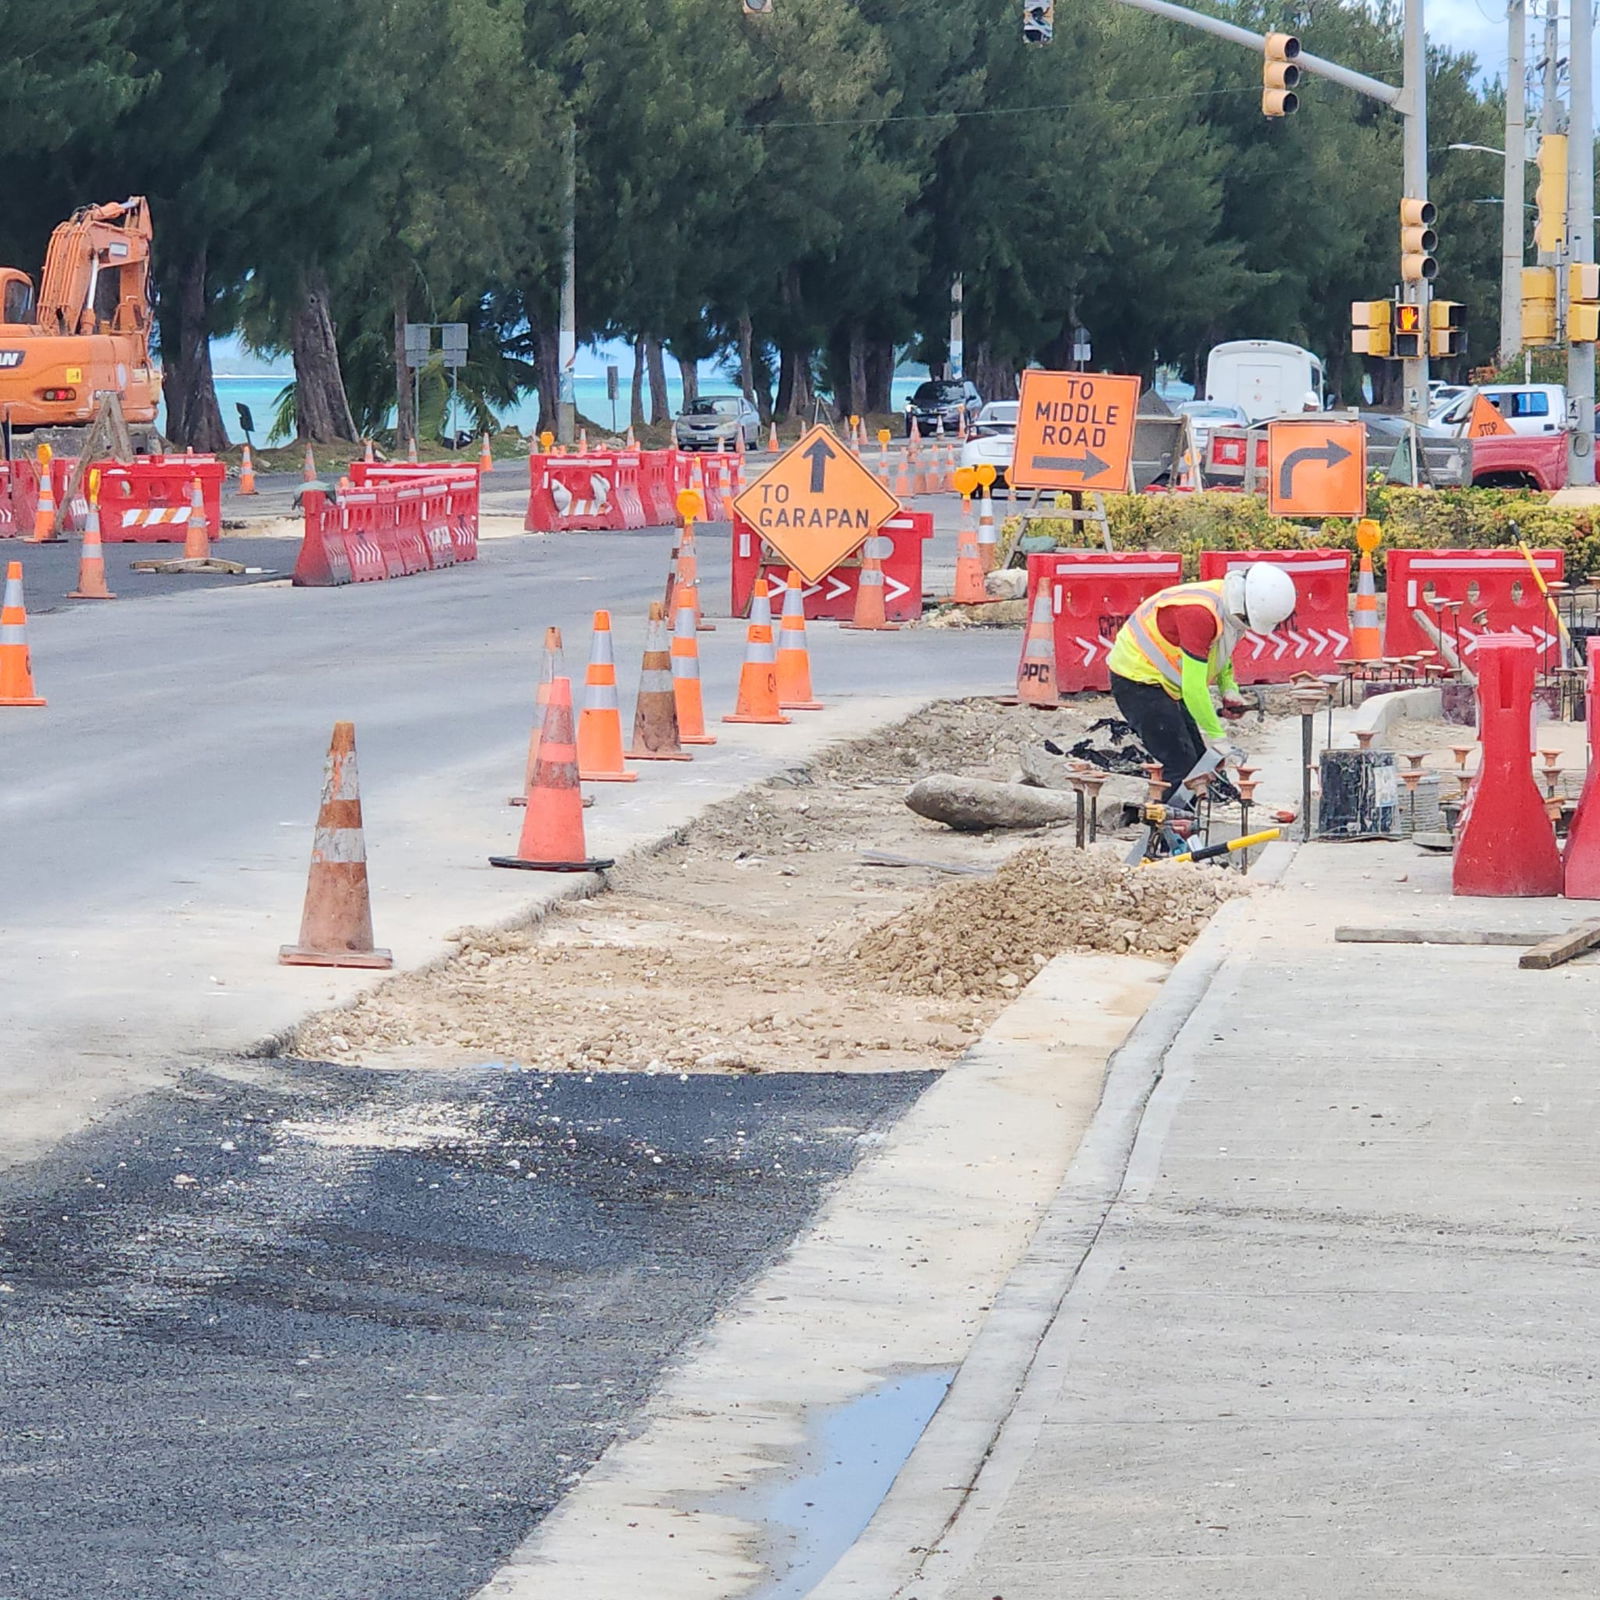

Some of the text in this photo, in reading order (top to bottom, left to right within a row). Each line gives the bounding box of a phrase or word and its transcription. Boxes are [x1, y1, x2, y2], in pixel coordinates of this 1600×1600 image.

[1067, 380, 1094, 400] TO
[1035, 401, 1119, 425] MIDDLE
[1042, 425, 1106, 448] ROAD
[1478, 421, 1498, 437] STOP
[760, 484, 789, 504] TO
[759, 508, 869, 528] GARAPAN
